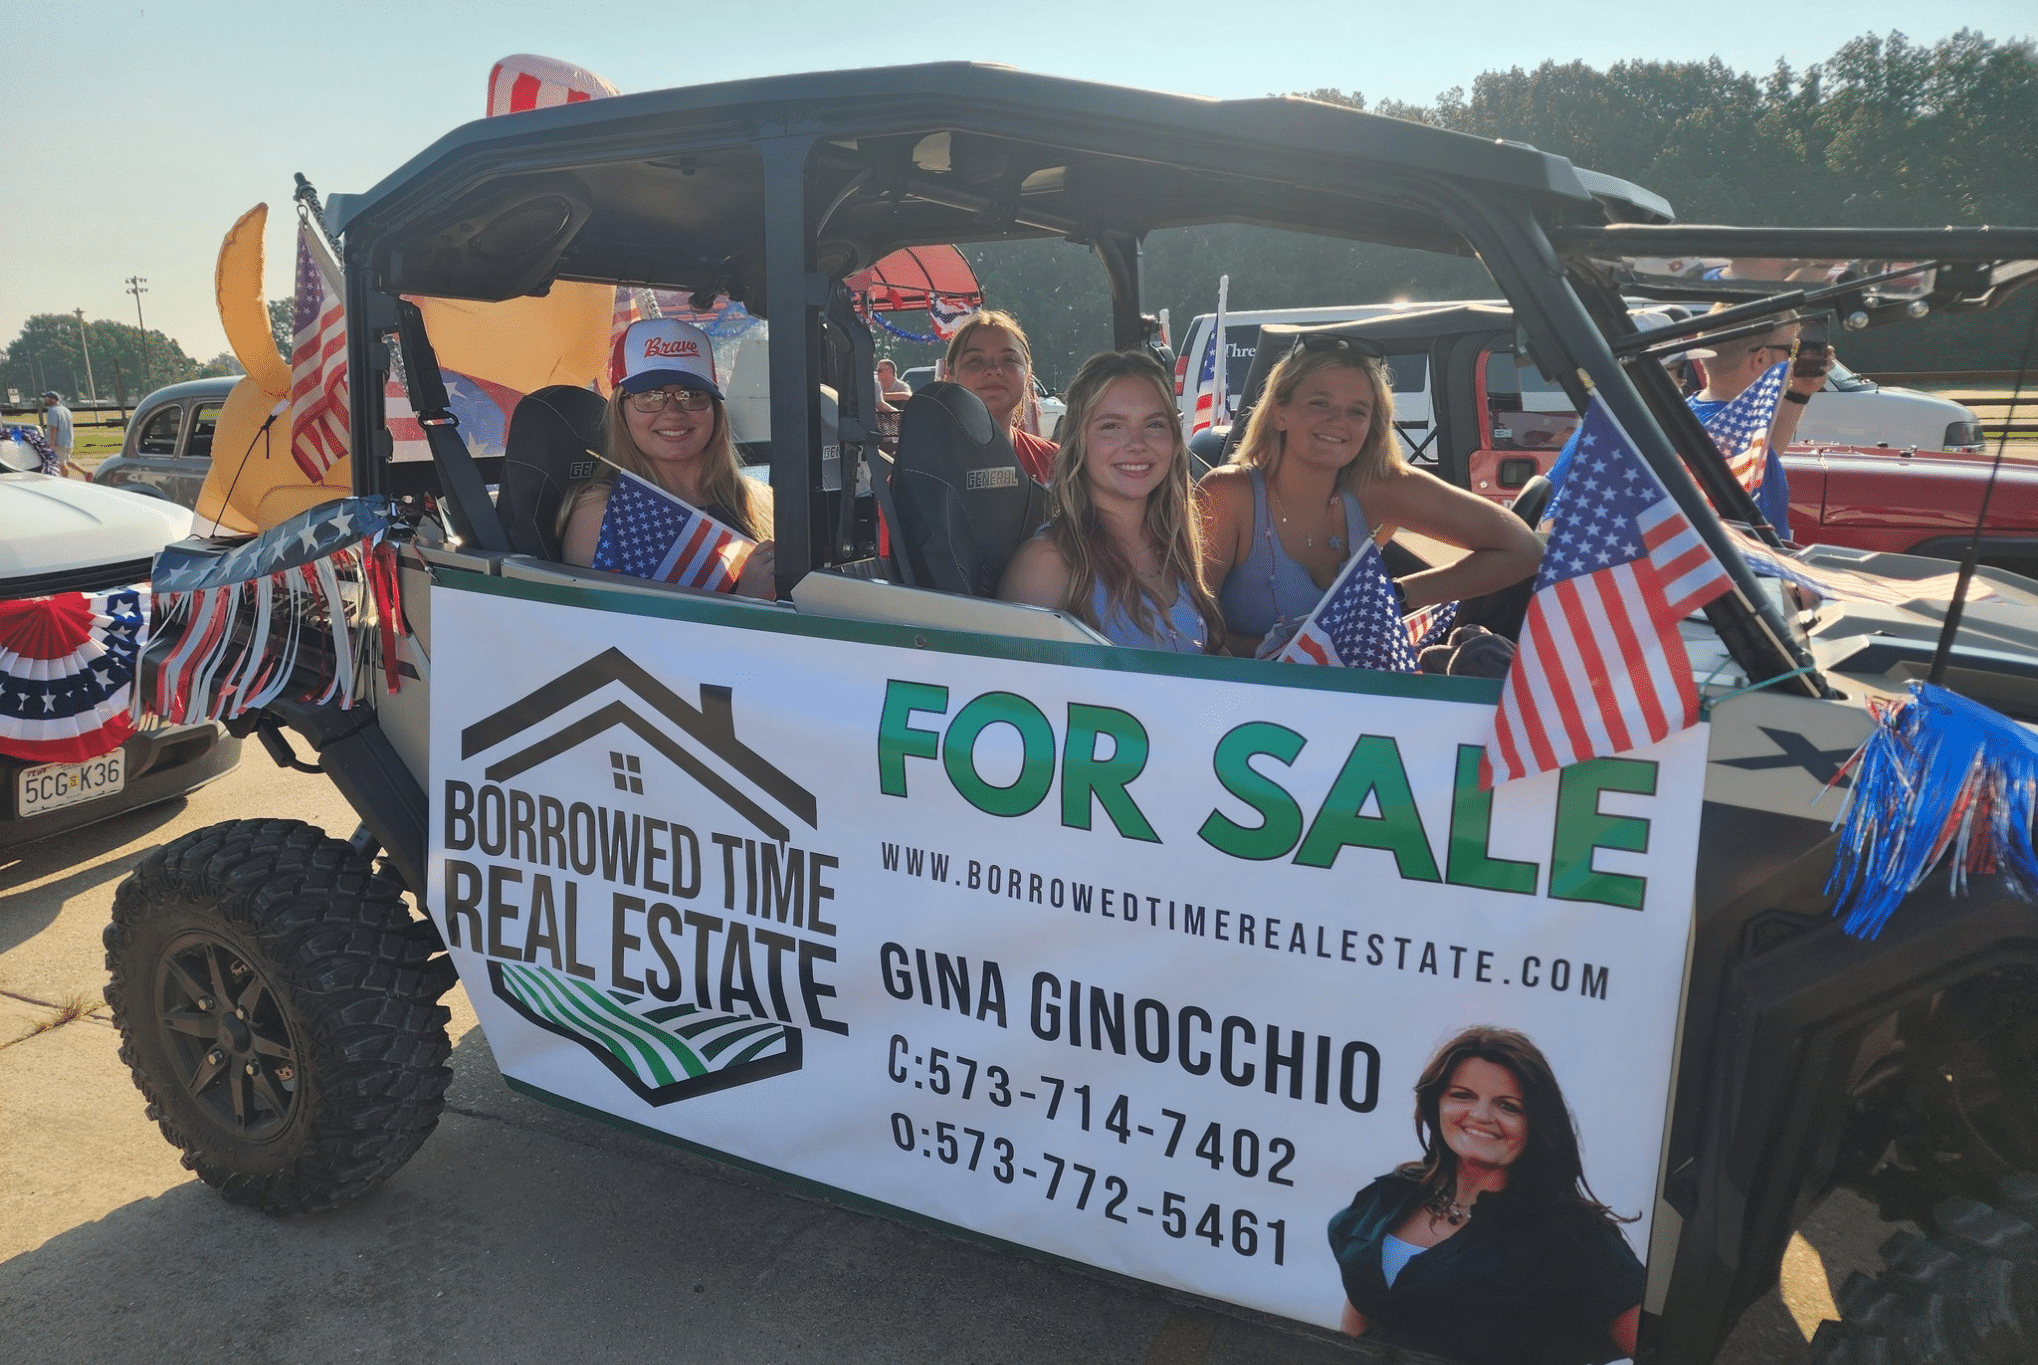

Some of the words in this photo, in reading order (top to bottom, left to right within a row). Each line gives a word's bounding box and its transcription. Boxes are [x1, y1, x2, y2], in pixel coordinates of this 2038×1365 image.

[644, 337, 700, 358] Brave
[966, 466, 1018, 490] GENERAL
[26, 772, 68, 804] 5CG
[80, 759, 119, 791] K36
[444, 779, 701, 899] BORROWED
[711, 832, 839, 936] TIME
[878, 678, 1163, 844] FOR
[1197, 720, 1660, 911] SALE
[445, 858, 596, 981] REAL
[611, 892, 849, 1036] ESTATE
[881, 841, 1609, 1000] WWW.BORROWEDTIMEREALESTATE.COM
[880, 941, 1008, 1029] GINA
[1030, 971, 1381, 1114] GINOCCHIO
[888, 1033, 1296, 1188] C:573-714-7402
[891, 1112, 1286, 1266] O:573-772-5461
